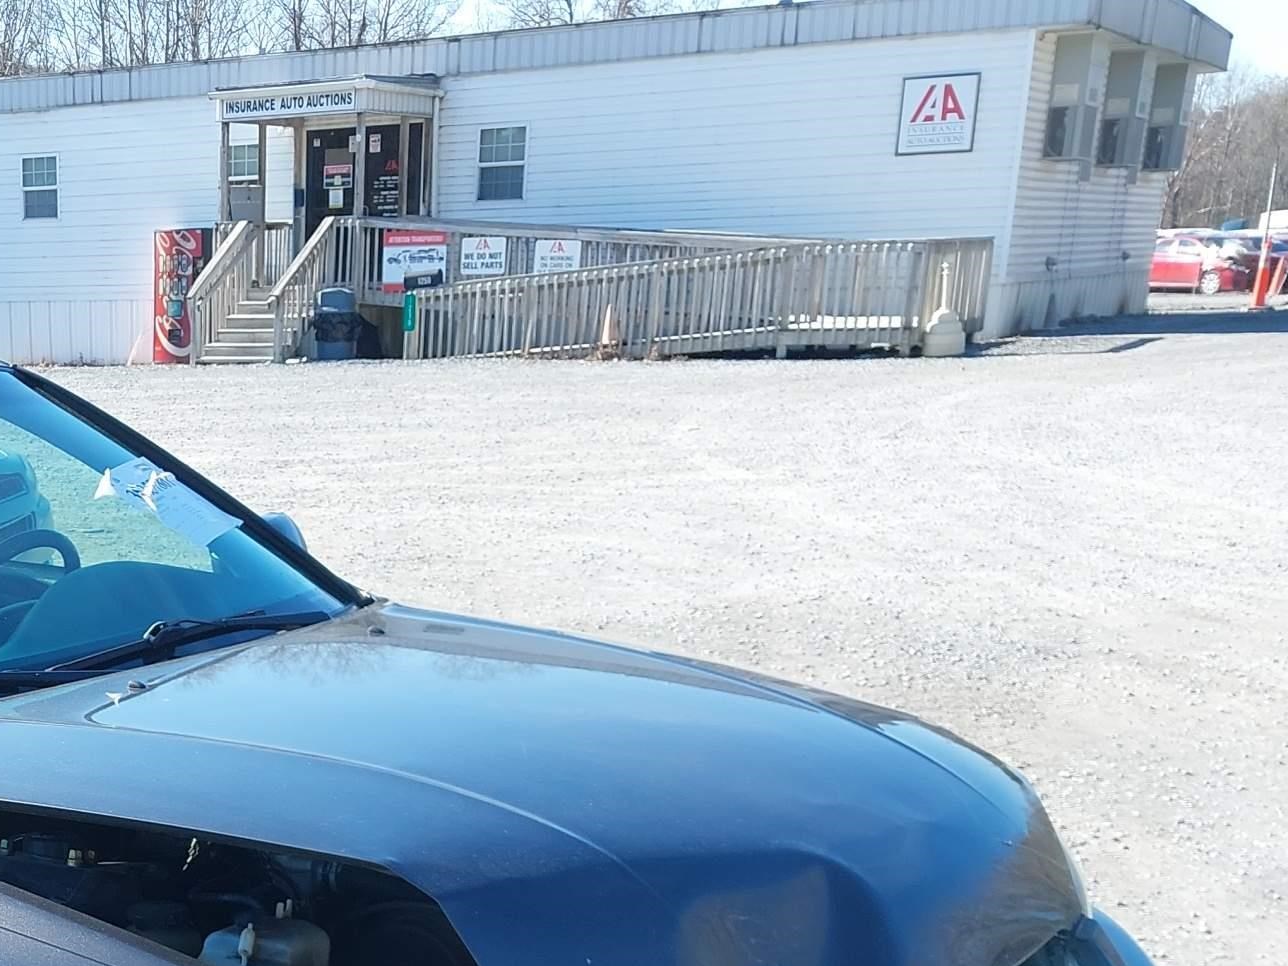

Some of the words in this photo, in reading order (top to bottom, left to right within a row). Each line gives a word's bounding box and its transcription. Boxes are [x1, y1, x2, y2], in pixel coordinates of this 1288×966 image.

[225, 99, 275, 114] INSURANCE
[280, 96, 304, 110] AUTO
[306, 91, 353, 107] AUCTIONS
[463, 253, 474, 261] WE
[476, 252, 487, 260] DO
[488, 251, 503, 260] NOT
[462, 261, 478, 270] SELL
[481, 260, 503, 269] PARTS
